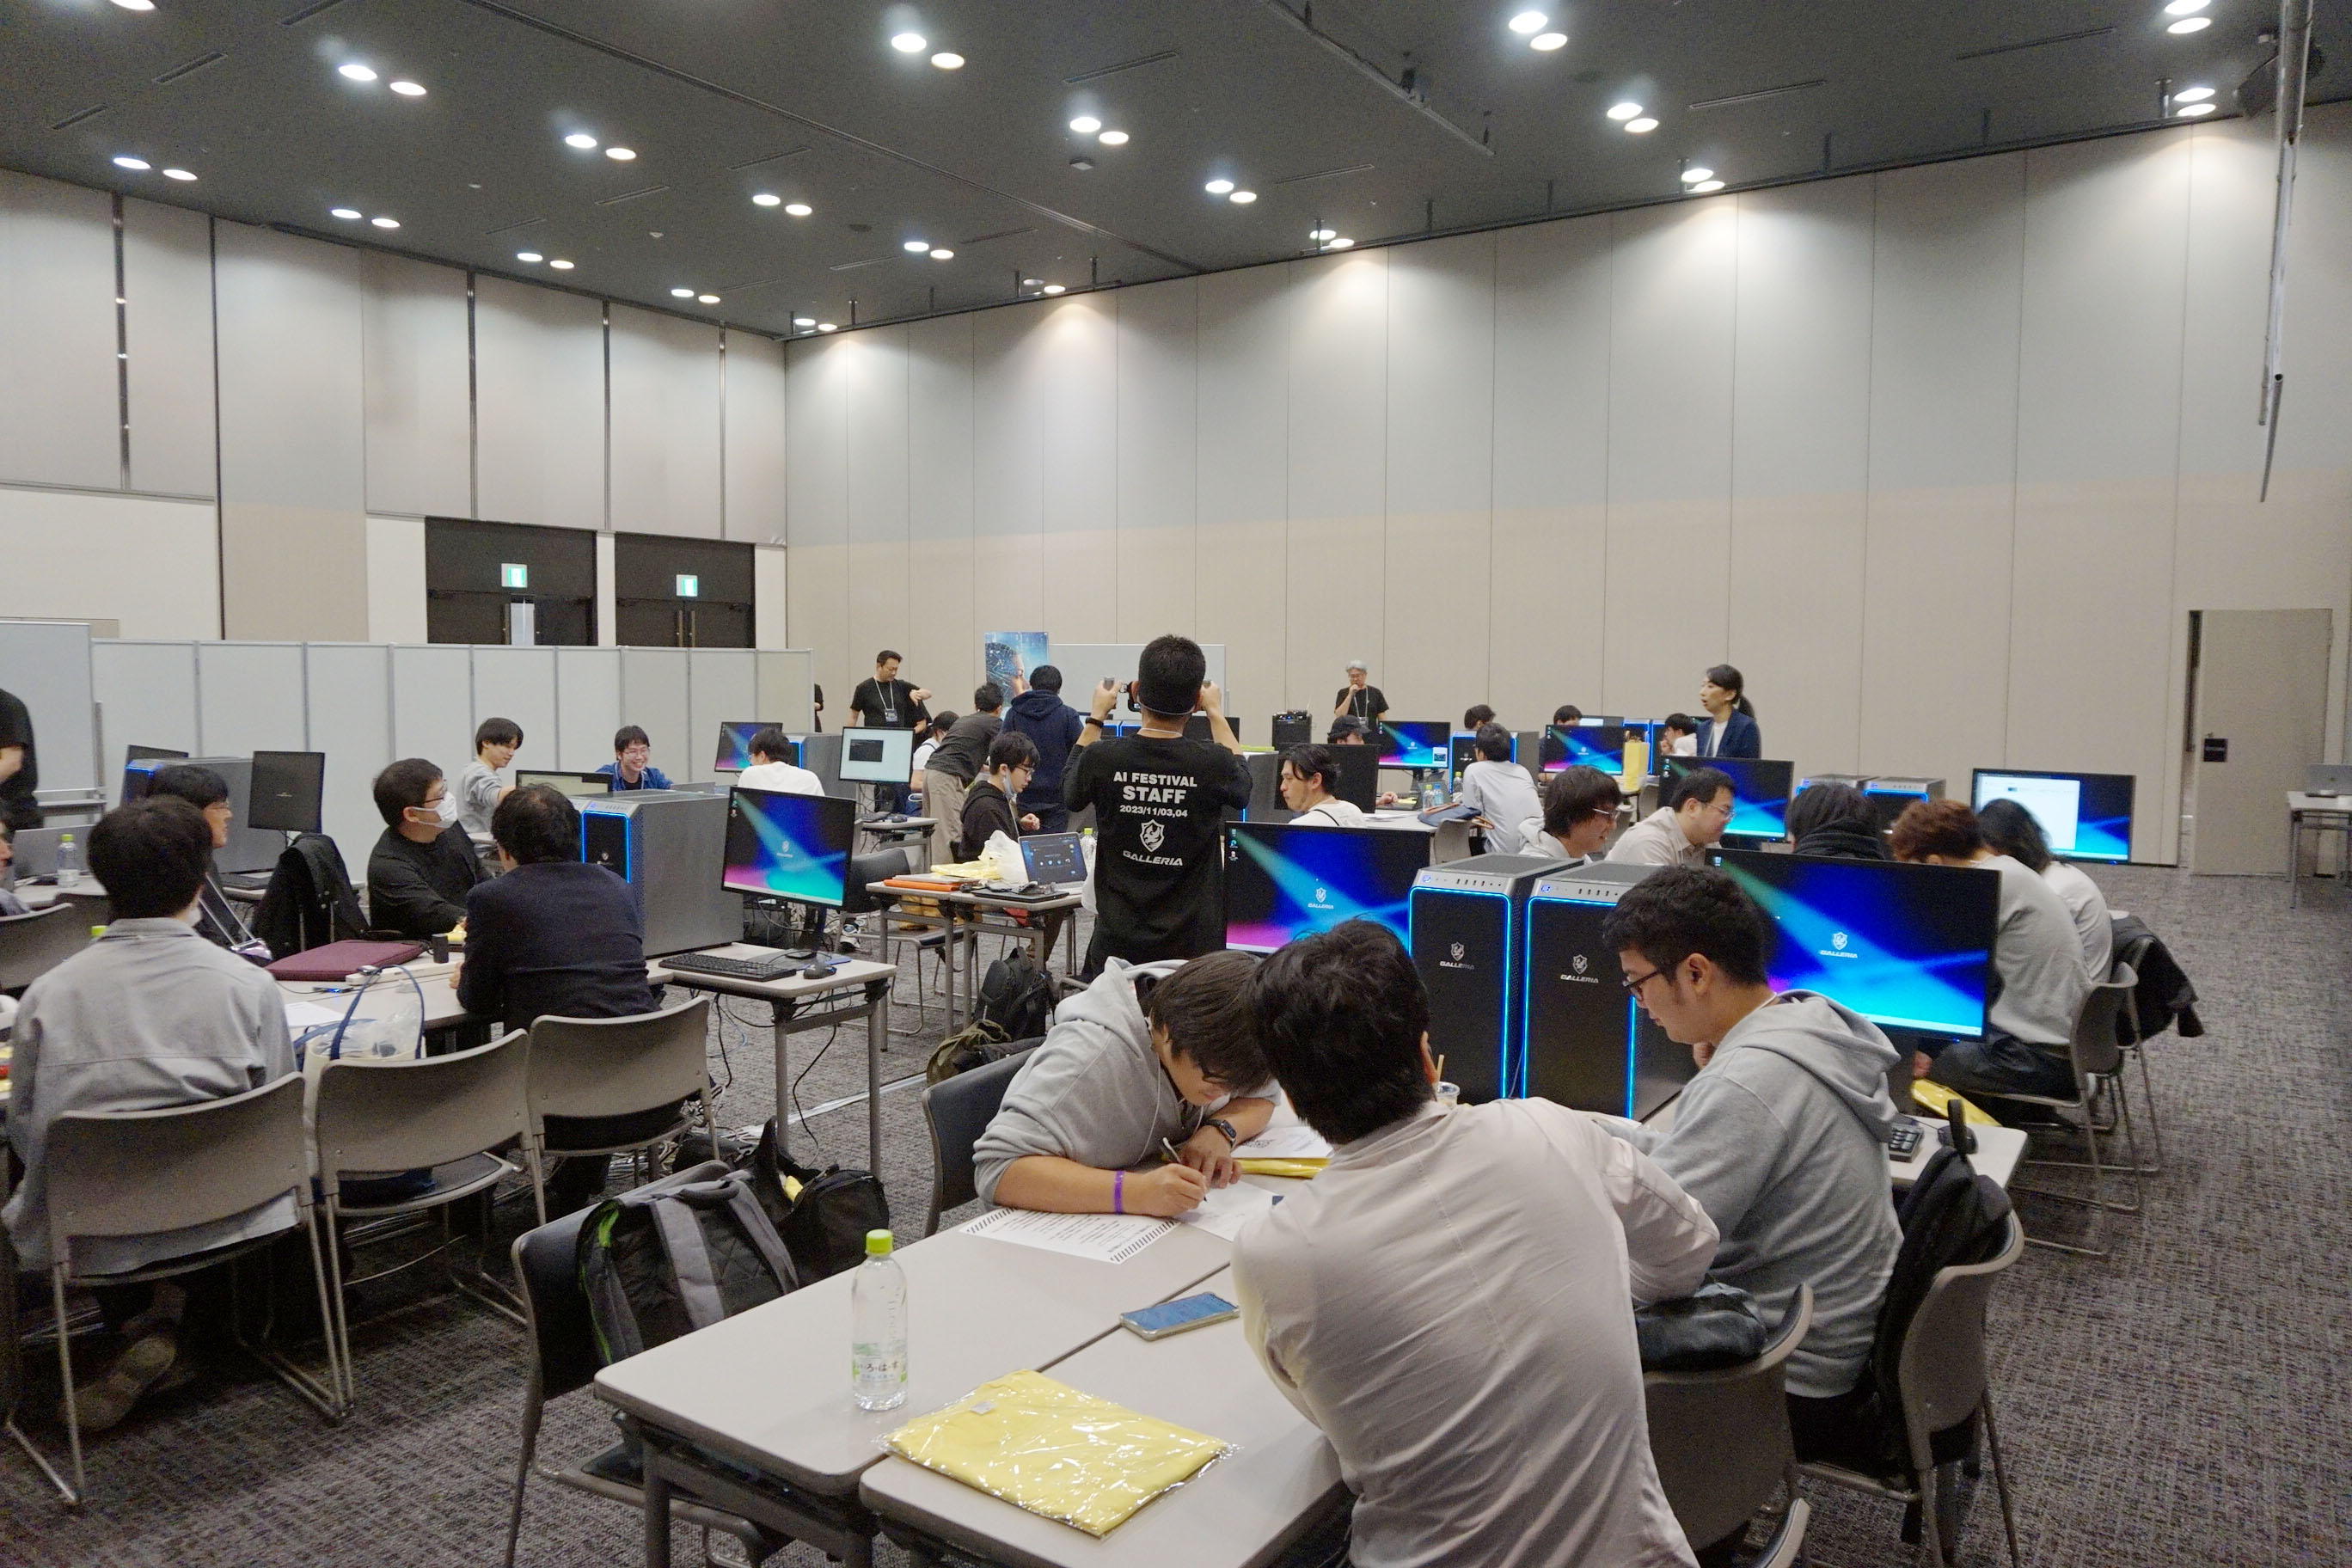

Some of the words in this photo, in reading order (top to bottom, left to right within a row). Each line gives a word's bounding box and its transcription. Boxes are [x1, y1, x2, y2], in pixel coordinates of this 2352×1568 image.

[1113, 771, 1128, 782] AI
[1131, 772, 1197, 787] FESTIVAL
[1122, 785, 1187, 804] STAFF
[1119, 805, 1188, 818] 2023/11/03,04
[1123, 850, 1184, 867] GALLERIA
[1439, 960, 1475, 970] GALLERIA
[1560, 974, 1599, 983] GALLERIA
